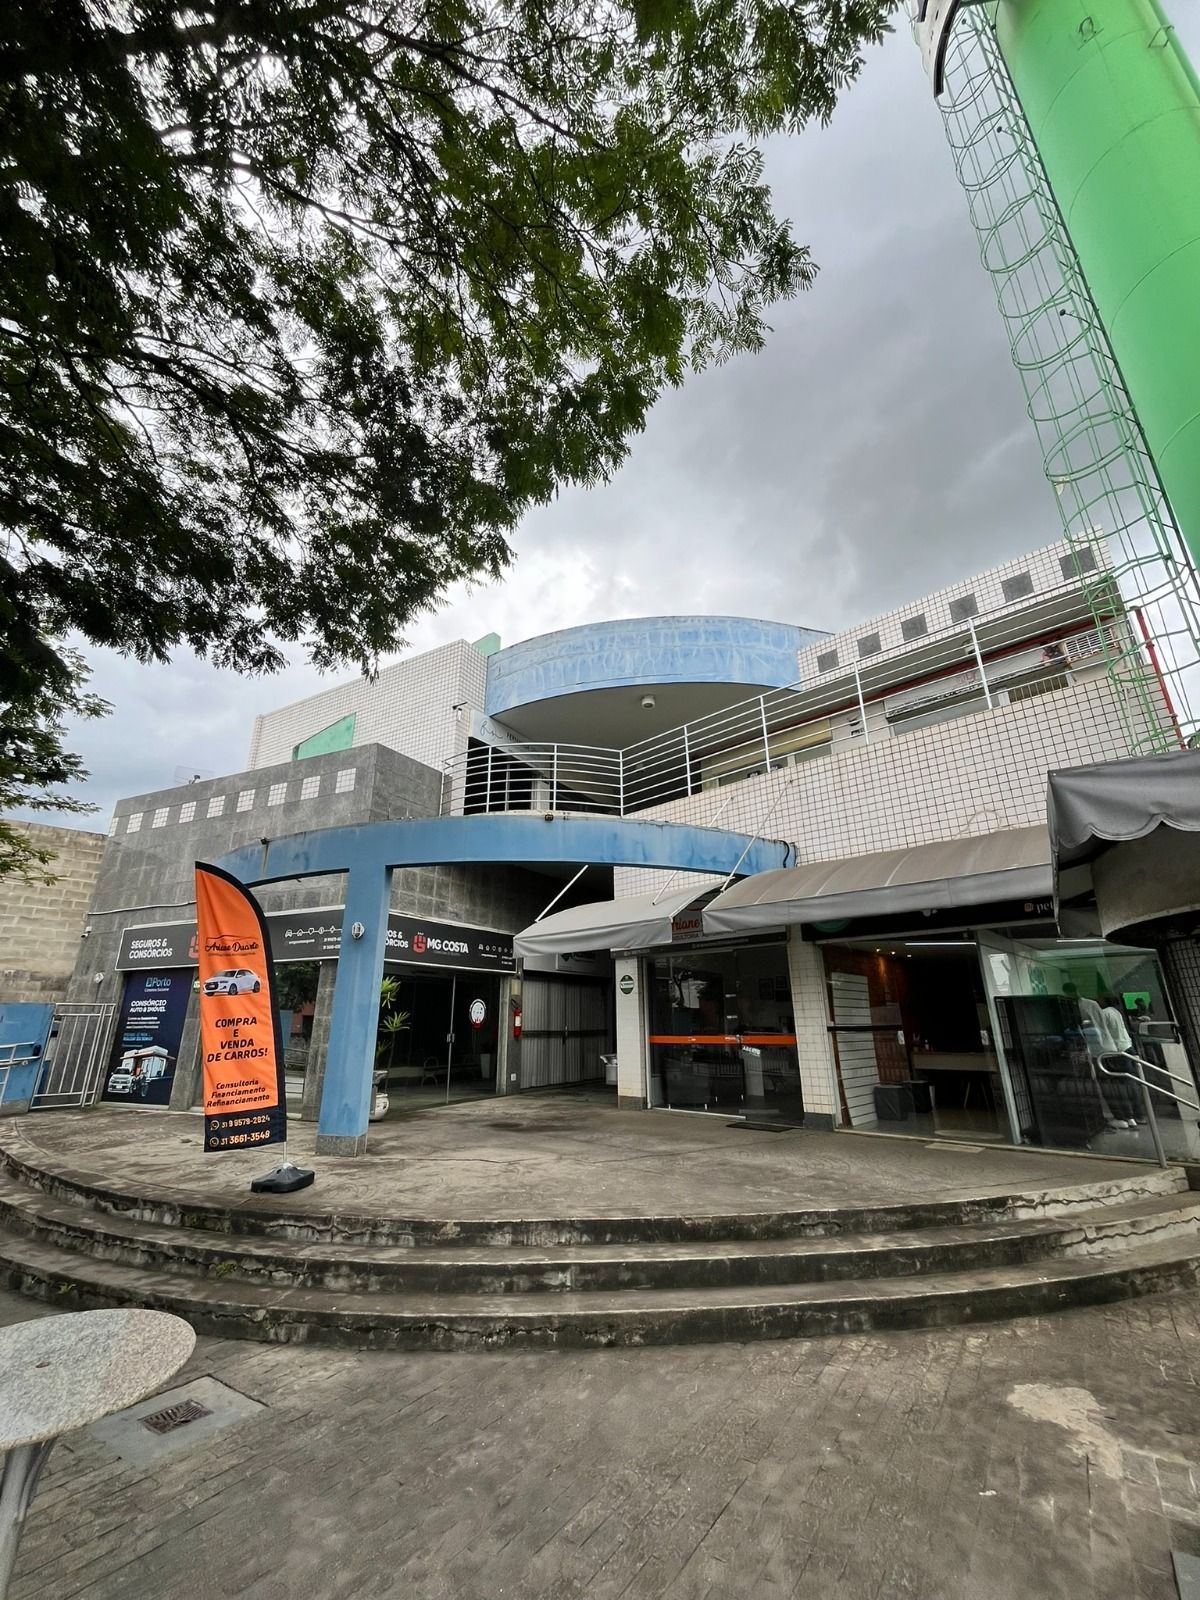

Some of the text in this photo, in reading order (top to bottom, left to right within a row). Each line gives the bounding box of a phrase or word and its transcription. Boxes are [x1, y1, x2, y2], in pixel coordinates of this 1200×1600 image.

[131, 938, 162, 949] SEGUROS
[427, 937, 442, 950] MG
[442, 940, 469, 954] COSTA
[129, 947, 173, 959] CONSÓRCIOS
[152, 976, 172, 988] Porto
[215, 1016, 258, 1028] COMPRA
[233, 1028, 239, 1038] E
[220, 1038, 254, 1050] VENDA
[207, 1047, 268, 1063] DE CARROS!
[216, 1079, 259, 1090] Consultoria
[211, 1086, 266, 1099] Financiamento
[206, 1094, 270, 1108] Refinanciamento
[221, 1121, 228, 1129] 31
[220, 1137, 228, 1146] 31
